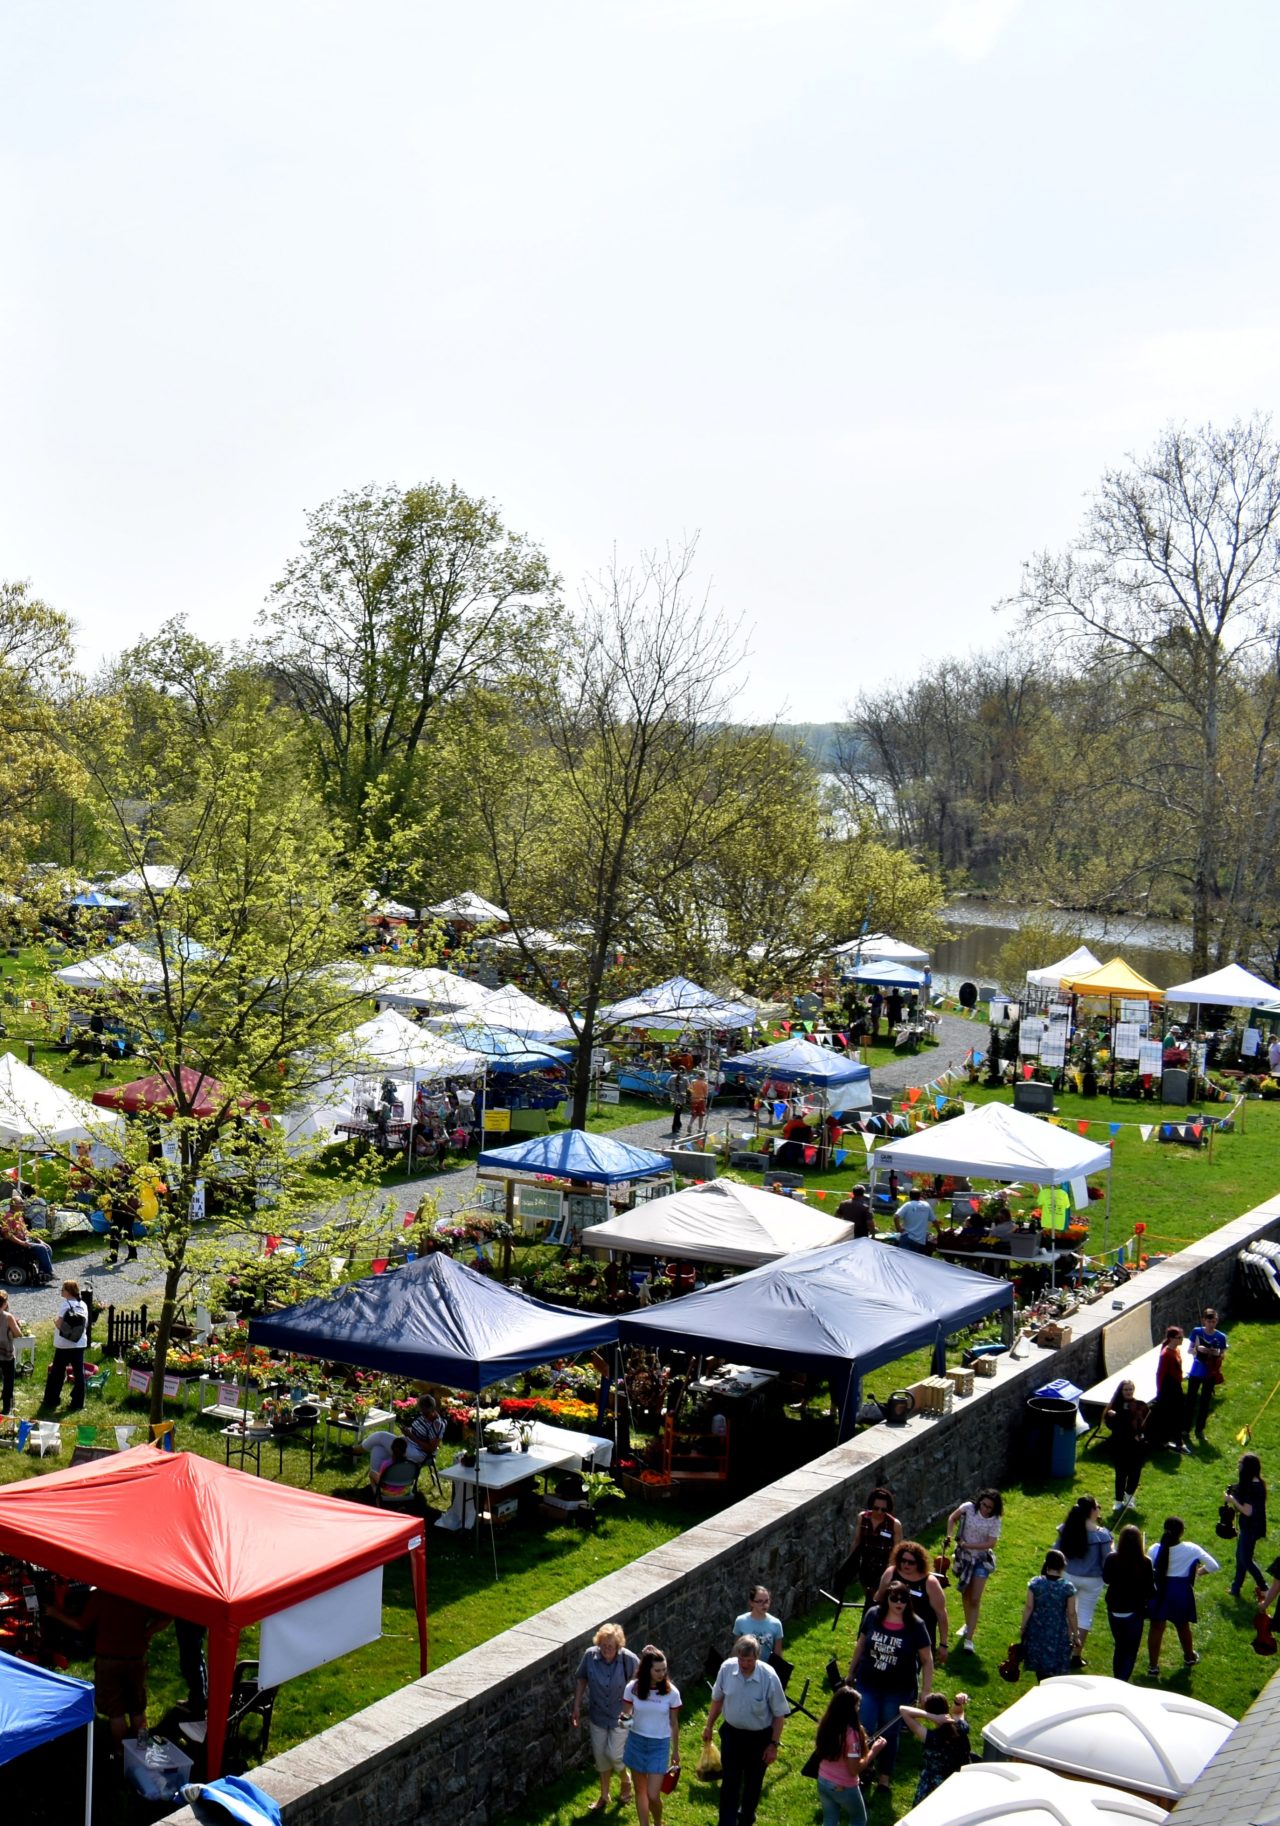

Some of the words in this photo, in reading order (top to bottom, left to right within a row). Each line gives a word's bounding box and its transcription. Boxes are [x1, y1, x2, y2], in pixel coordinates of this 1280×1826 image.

[871, 1630, 888, 1644] MAY
[889, 1636, 903, 1649] THE
[873, 1641, 896, 1653] FORCE
